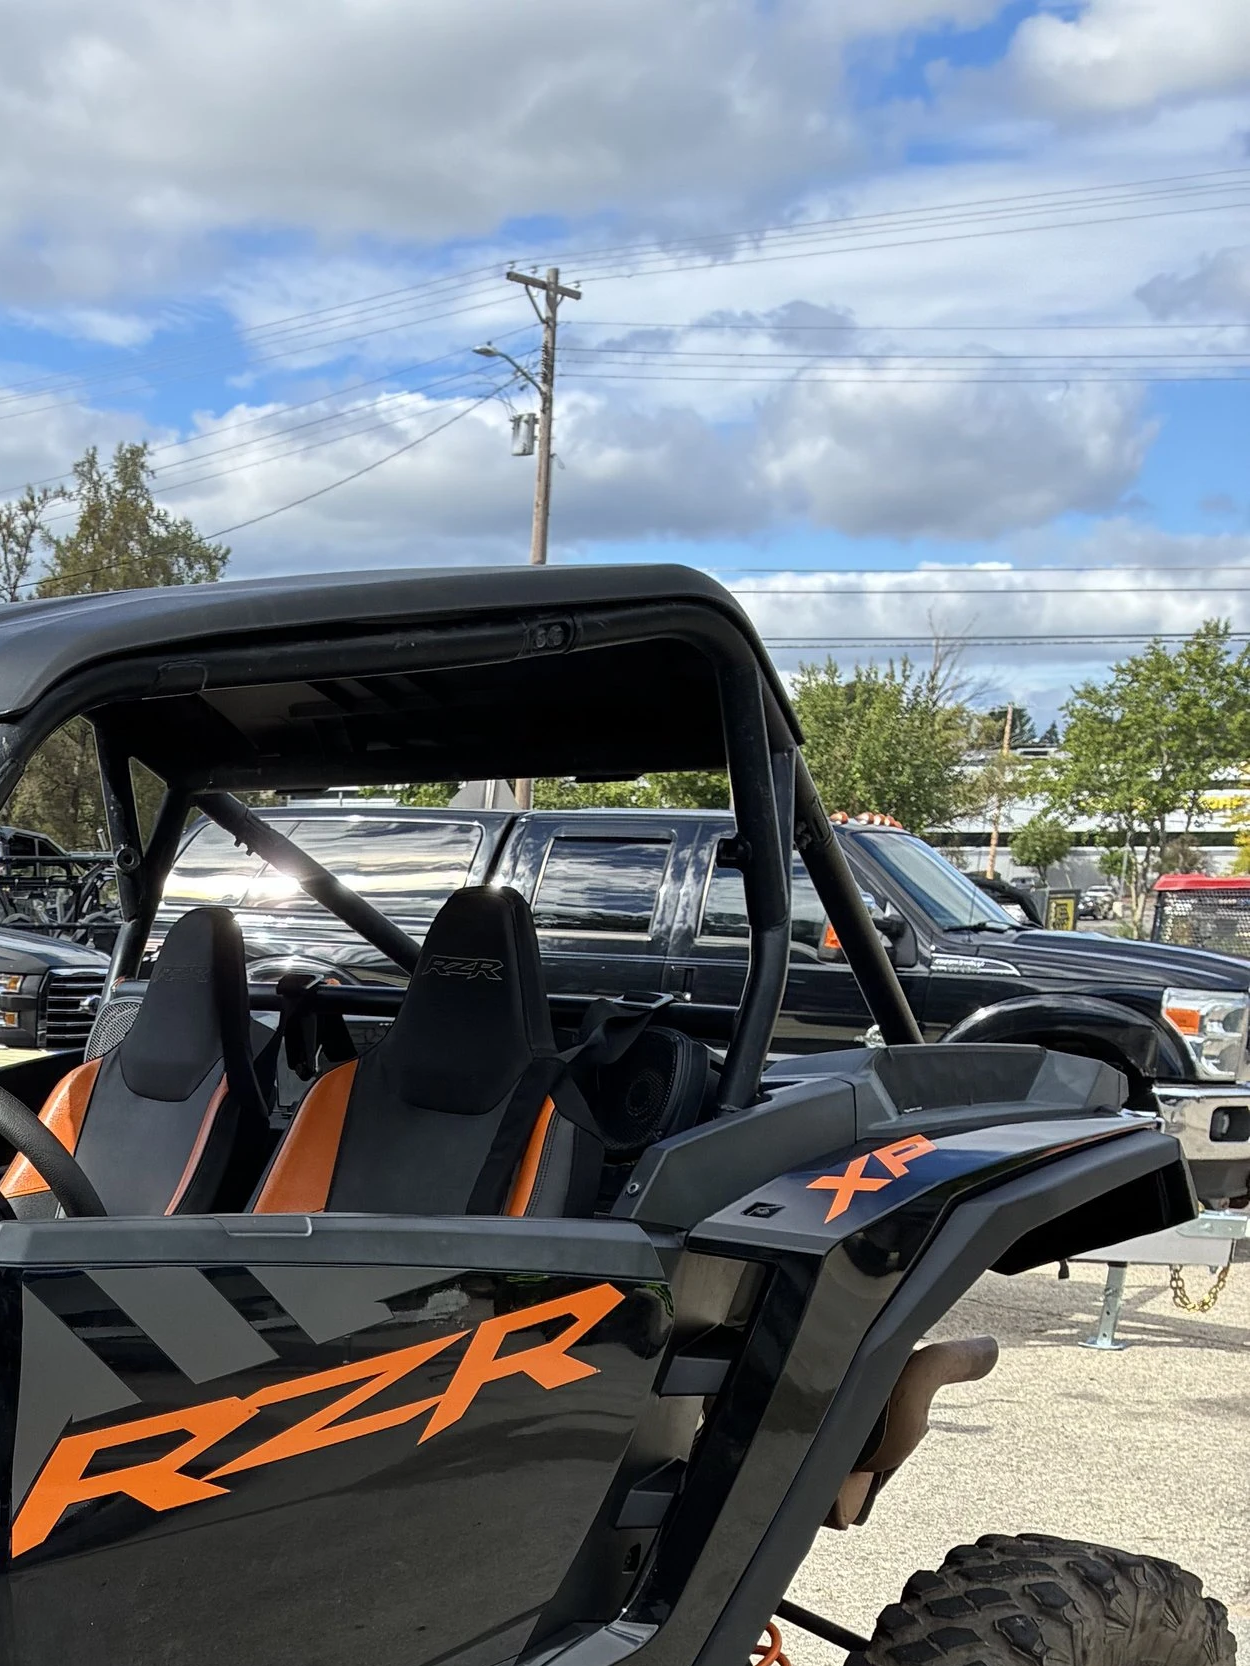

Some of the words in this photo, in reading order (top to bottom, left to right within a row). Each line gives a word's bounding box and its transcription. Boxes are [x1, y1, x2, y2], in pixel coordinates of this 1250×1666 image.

[422, 954, 504, 981] RZR
[805, 1133, 938, 1224] XP
[12, 1283, 626, 1560] RZR
